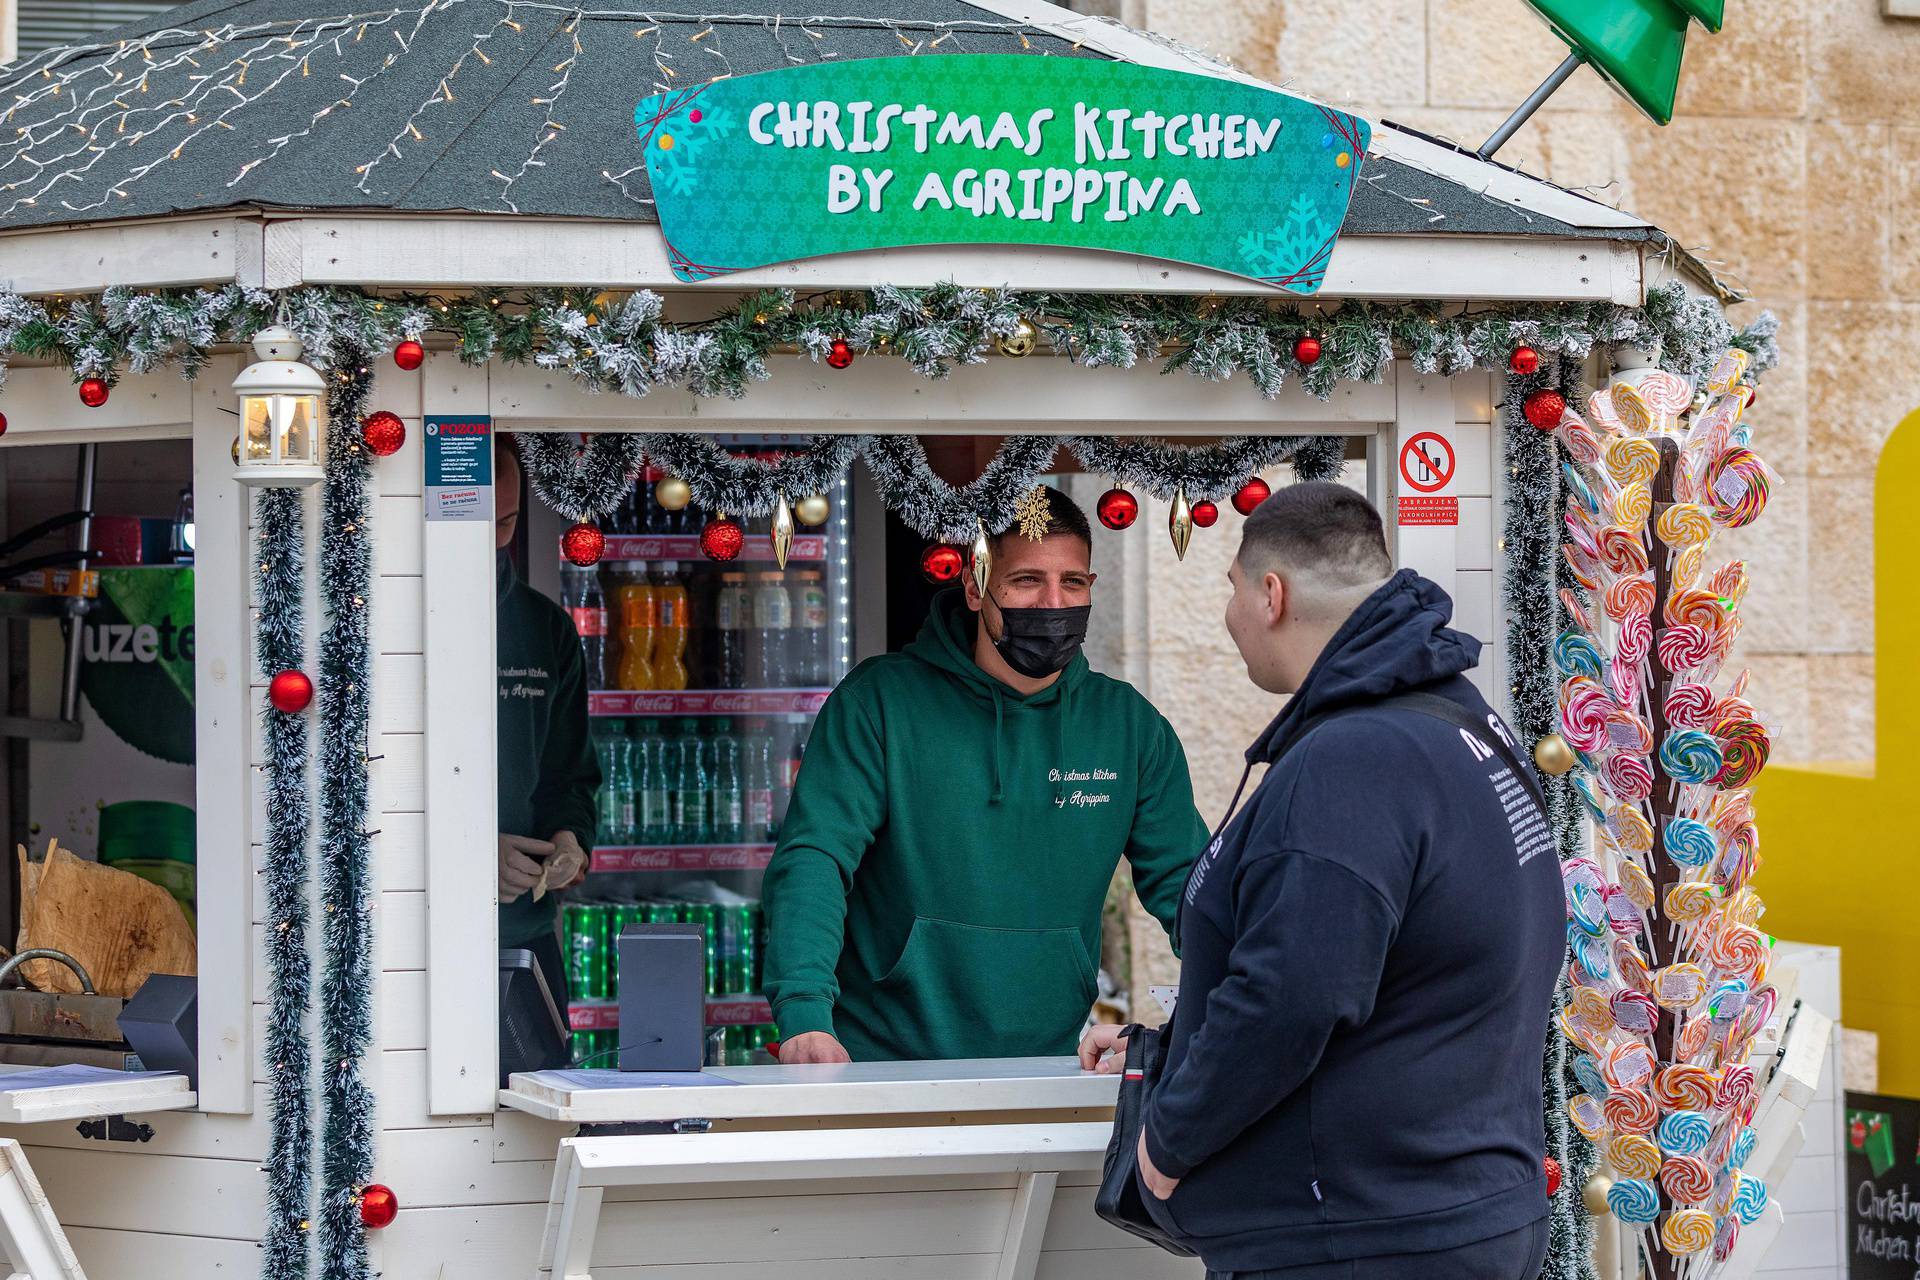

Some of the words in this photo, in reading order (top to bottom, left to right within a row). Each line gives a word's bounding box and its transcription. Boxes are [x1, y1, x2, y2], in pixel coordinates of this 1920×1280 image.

[748, 100, 1054, 157] CHRISTMAS
[1074, 102, 1282, 164] KITCHEN
[827, 164, 892, 213] BY
[913, 168, 1201, 222] AGRIPPINA
[83, 614, 195, 663] uzete
[1069, 790, 1110, 808] Agrippina
[572, 931, 583, 983] PAN
[1856, 1223, 1910, 1262] Kitchen
